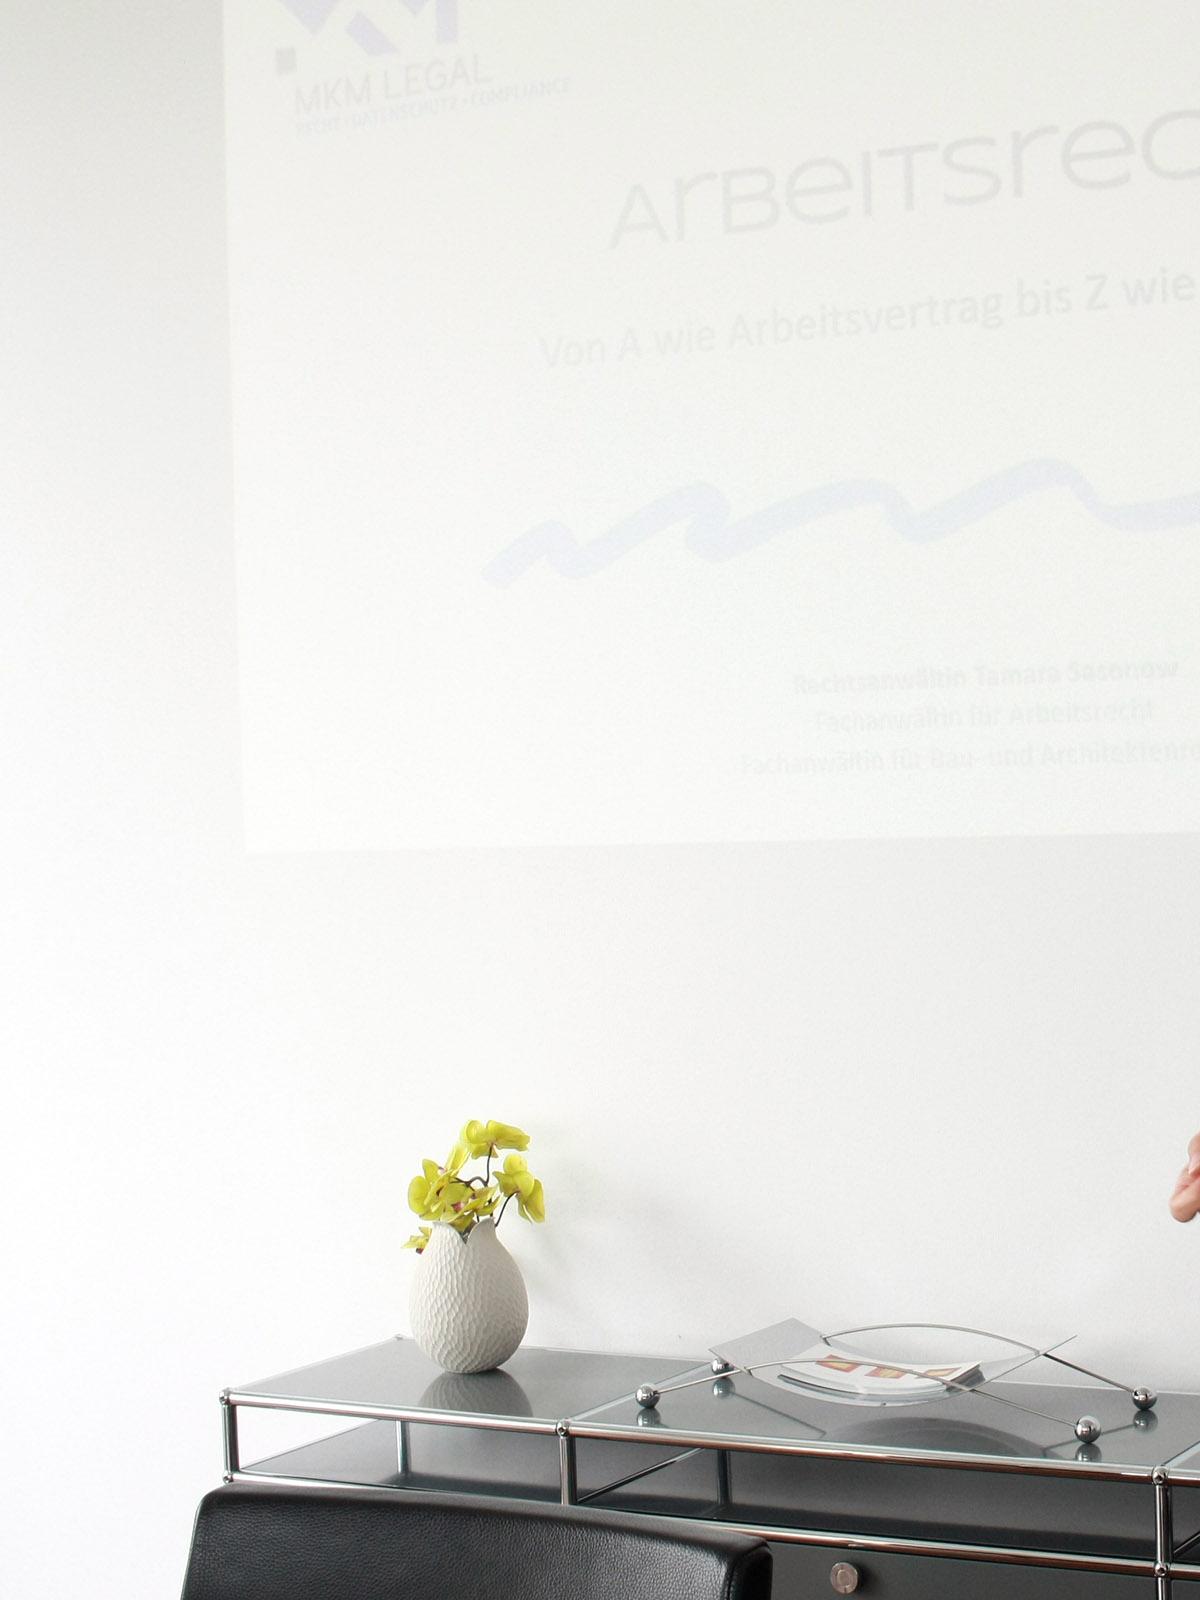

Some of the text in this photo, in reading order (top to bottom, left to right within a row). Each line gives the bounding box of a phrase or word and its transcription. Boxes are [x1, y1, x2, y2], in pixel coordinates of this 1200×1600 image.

[295, 53, 495, 115] MKM LEGAL
[538, 334, 606, 368] Von
[616, 326, 644, 362] A
[654, 320, 716, 357] wie
[727, 292, 1005, 349] Arbeitsvertrag
[1016, 273, 1074, 319] bis
[1084, 274, 1111, 311] Z
[1121, 262, 1197, 306] wie
[974, 665, 1061, 687] Tamara
